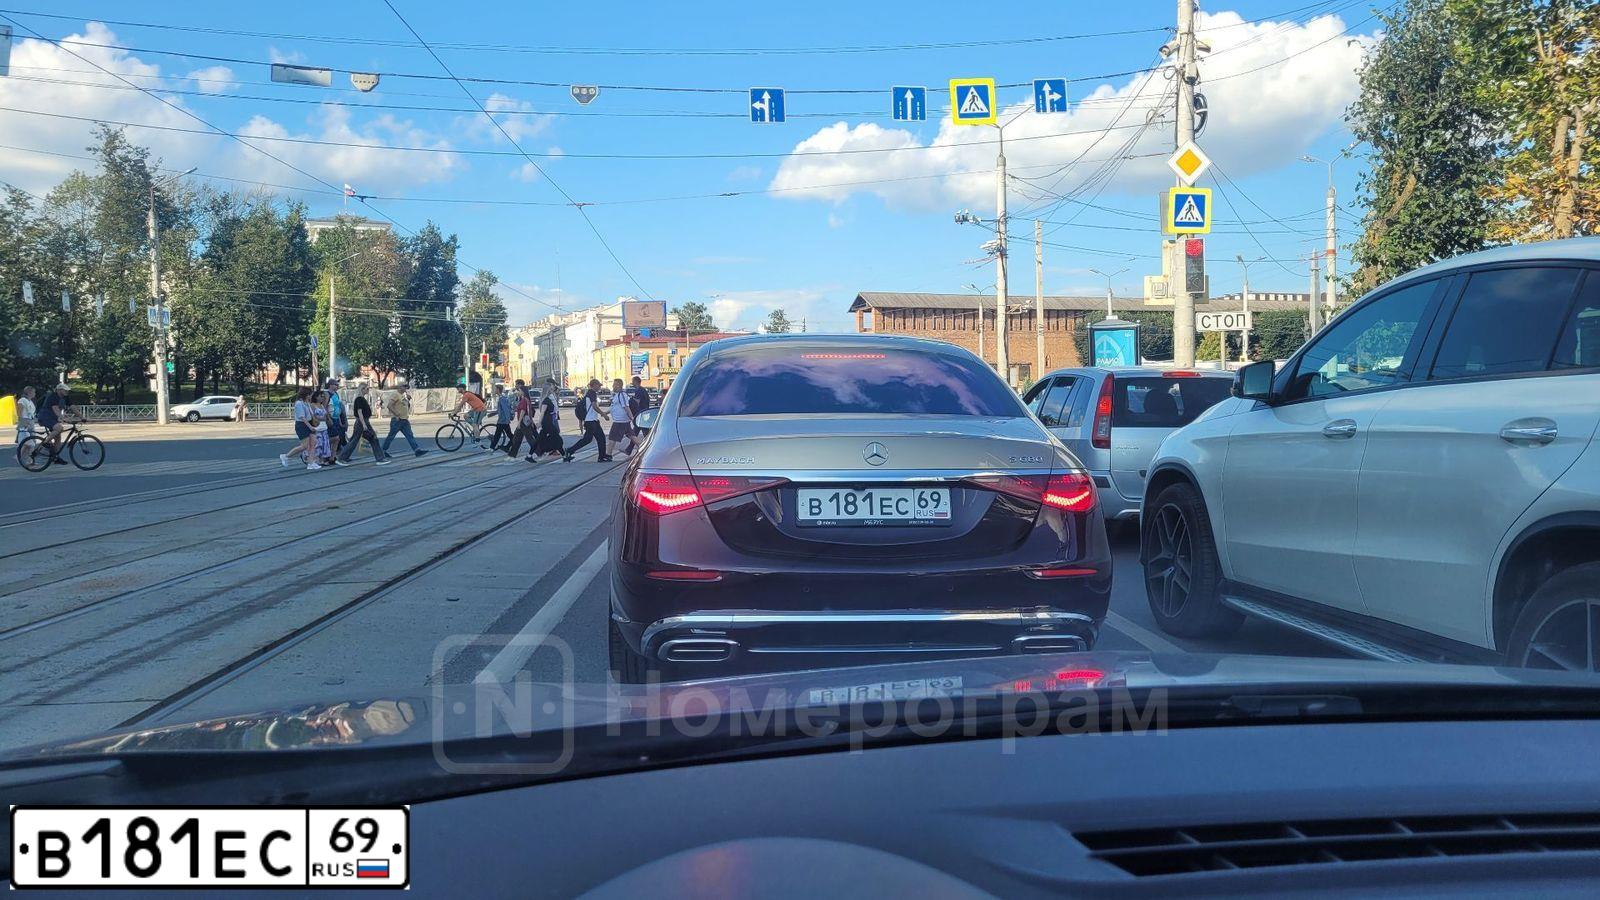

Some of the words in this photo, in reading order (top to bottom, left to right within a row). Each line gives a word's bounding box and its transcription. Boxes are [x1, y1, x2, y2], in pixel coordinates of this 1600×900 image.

[1201, 313, 1247, 329] СТОП
[696, 456, 756, 465] MAYBACH
[1008, 456, 1017, 464] S
[1019, 456, 1045, 464] 680
[808, 491, 909, 516] В181ЕС
[917, 490, 942, 509] 69
[916, 509, 935, 517] RUS
